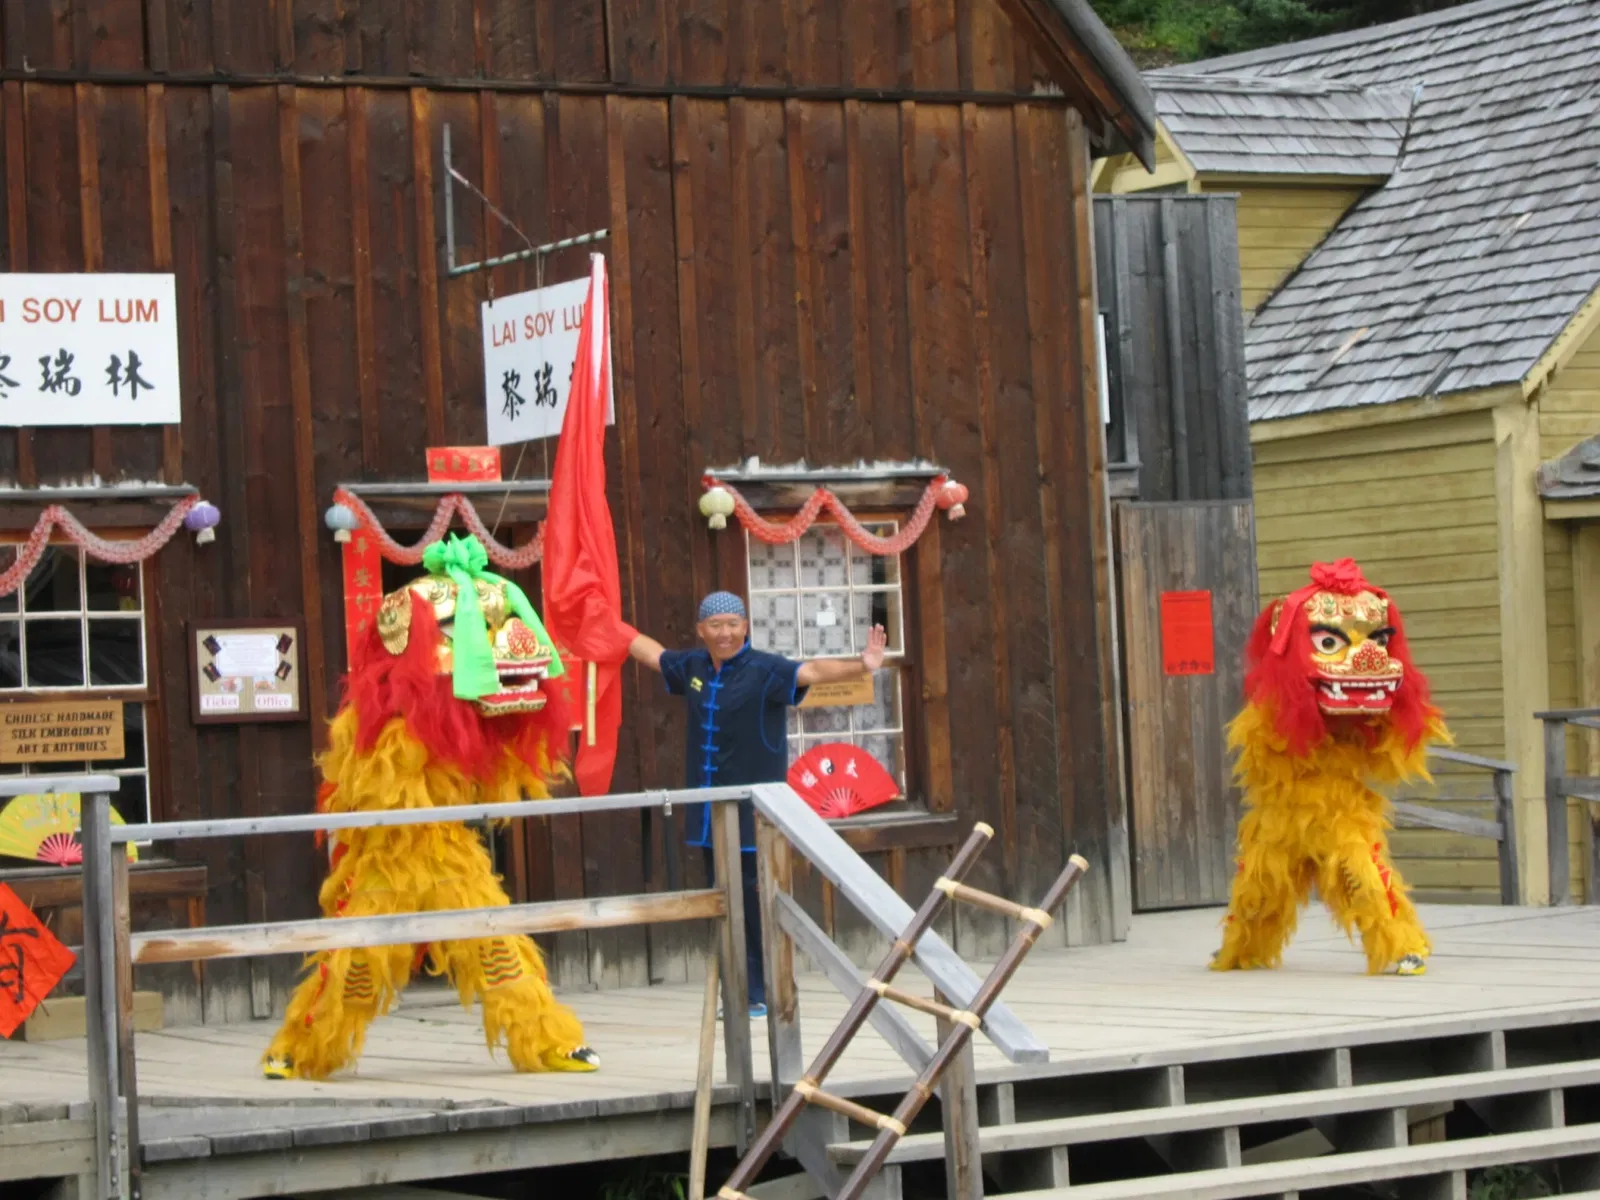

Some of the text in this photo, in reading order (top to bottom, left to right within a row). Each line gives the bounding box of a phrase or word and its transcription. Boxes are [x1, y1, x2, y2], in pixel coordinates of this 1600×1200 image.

[22, 298, 82, 323] SOY
[98, 298, 159, 323] LUM
[492, 303, 586, 347] LAI SOY LU
[501, 360, 576, 422] 黎瑞
[257, 695, 289, 706] Office
[5, 711, 114, 724] CHINESE HANDMADE
[11, 726, 111, 739] SILK EMBROIDERY
[16, 743, 37, 754] ART
[53, 741, 107, 753] ANTIQUES
